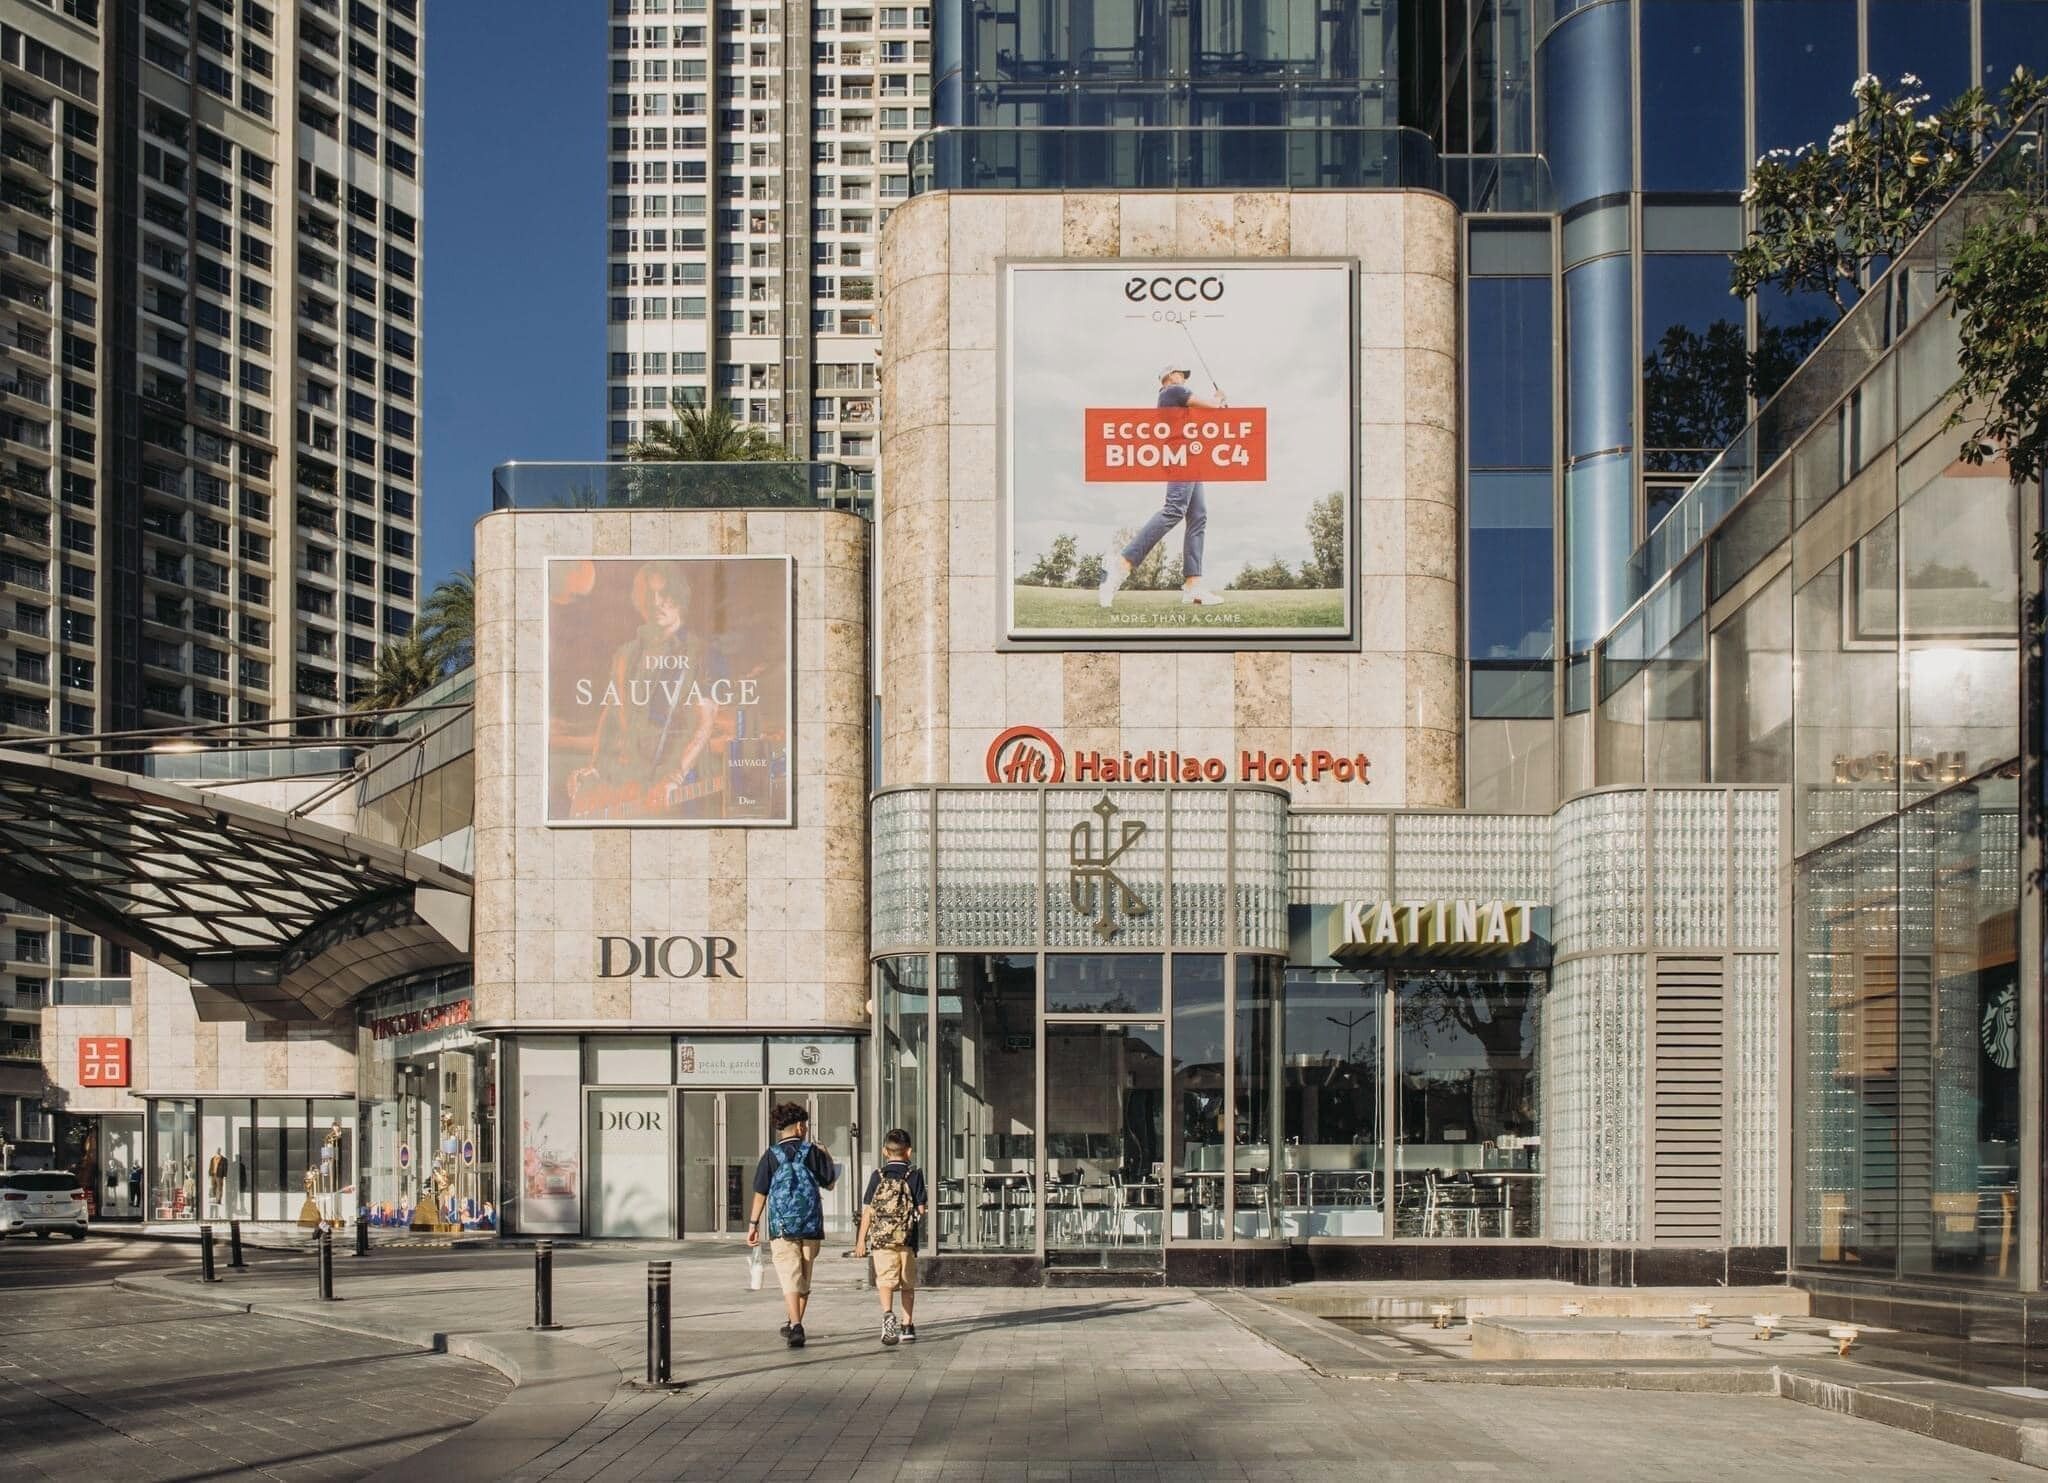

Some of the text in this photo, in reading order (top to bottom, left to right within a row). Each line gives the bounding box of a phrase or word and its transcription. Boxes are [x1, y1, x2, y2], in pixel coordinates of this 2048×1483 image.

[1125, 277, 1224, 301] ecco
[1152, 311, 1197, 322] GOLF
[1103, 422, 1252, 439] ECCO GOLF
[1211, 444, 1249, 467] C4
[1110, 614, 1241, 623] MORE THAN A GAME
[645, 655, 690, 669] DIOR
[576, 679, 760, 706] SAUVAGE
[728, 759, 768, 768] SAUVAGE
[1075, 750, 1226, 783] Haidilao
[739, 796, 756, 805] Dior
[1342, 899, 1537, 944] KATINAT
[597, 936, 744, 979] DIOR
[699, 1057, 726, 1070] peach
[729, 1057, 760, 1070] garden
[788, 1067, 834, 1076] BORNGA
[597, 1112, 662, 1130] DIOR
